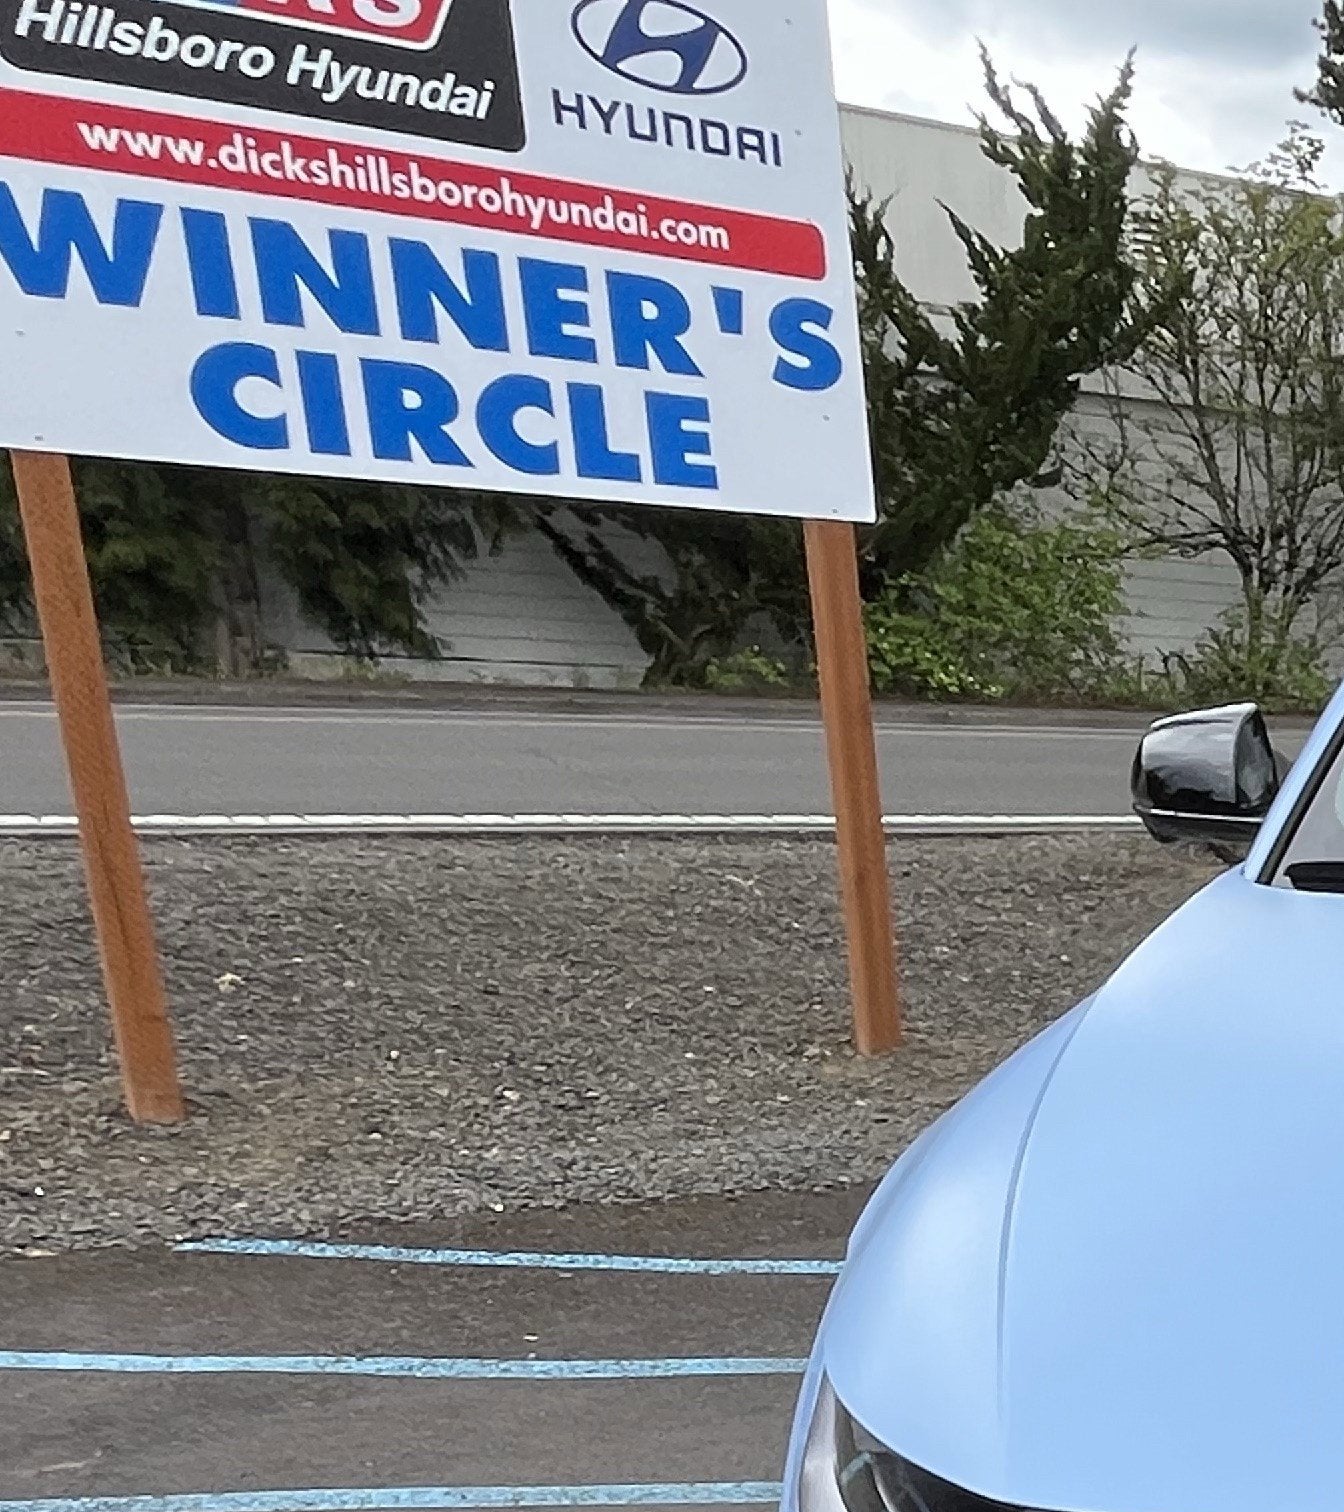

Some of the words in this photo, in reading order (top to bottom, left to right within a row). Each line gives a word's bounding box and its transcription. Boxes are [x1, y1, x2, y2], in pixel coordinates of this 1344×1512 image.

[15, 0, 275, 78] Hillsboro
[286, 43, 495, 120] Hyundai
[77, 120, 730, 251] www.dickshillsborohyundai.com
[552, 87, 782, 167] HYUNDAI
[0, 180, 843, 390] WINNER'S
[190, 341, 719, 489] CIRCLE
